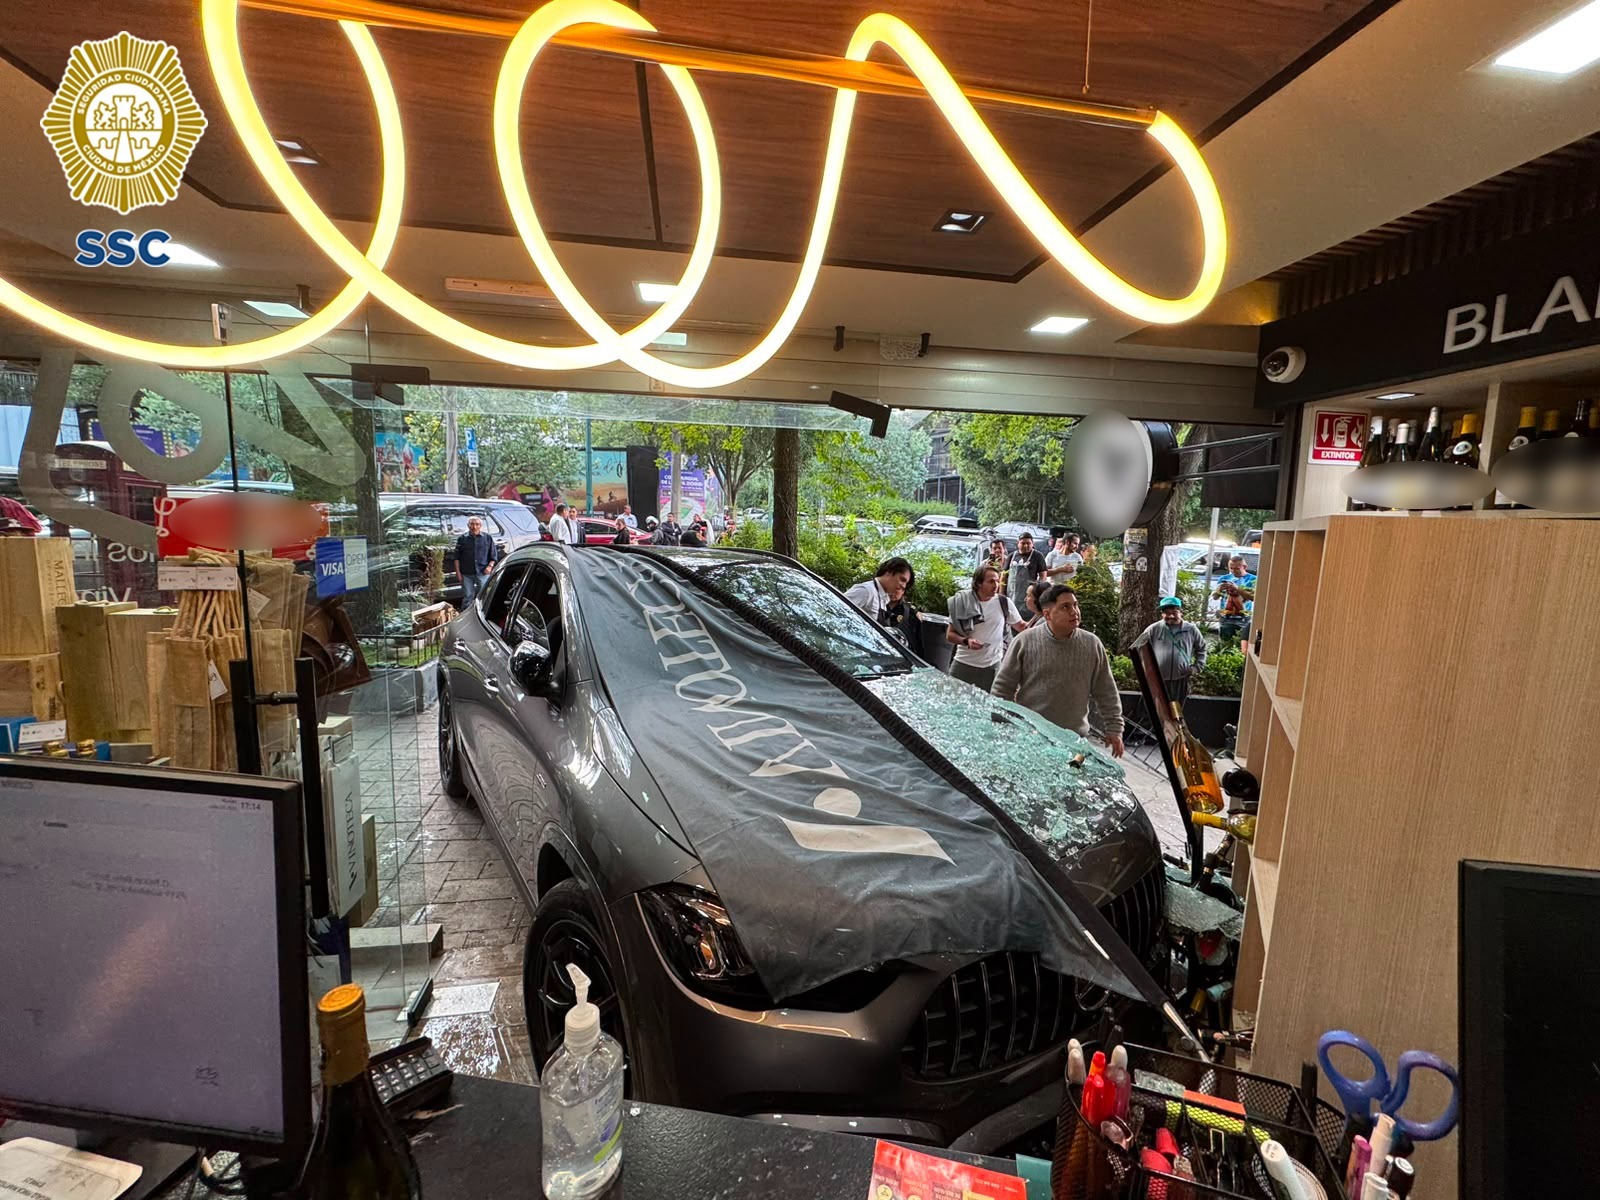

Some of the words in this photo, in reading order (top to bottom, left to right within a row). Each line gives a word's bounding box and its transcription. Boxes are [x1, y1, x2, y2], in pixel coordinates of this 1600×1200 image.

[1443, 275, 1600, 354] BLA
[1321, 451, 1356, 460] EXTINTOR
[320, 561, 345, 577] VISA
[240, 802, 261, 810] 17:14
[344, 791, 357, 873] VINOTECA
